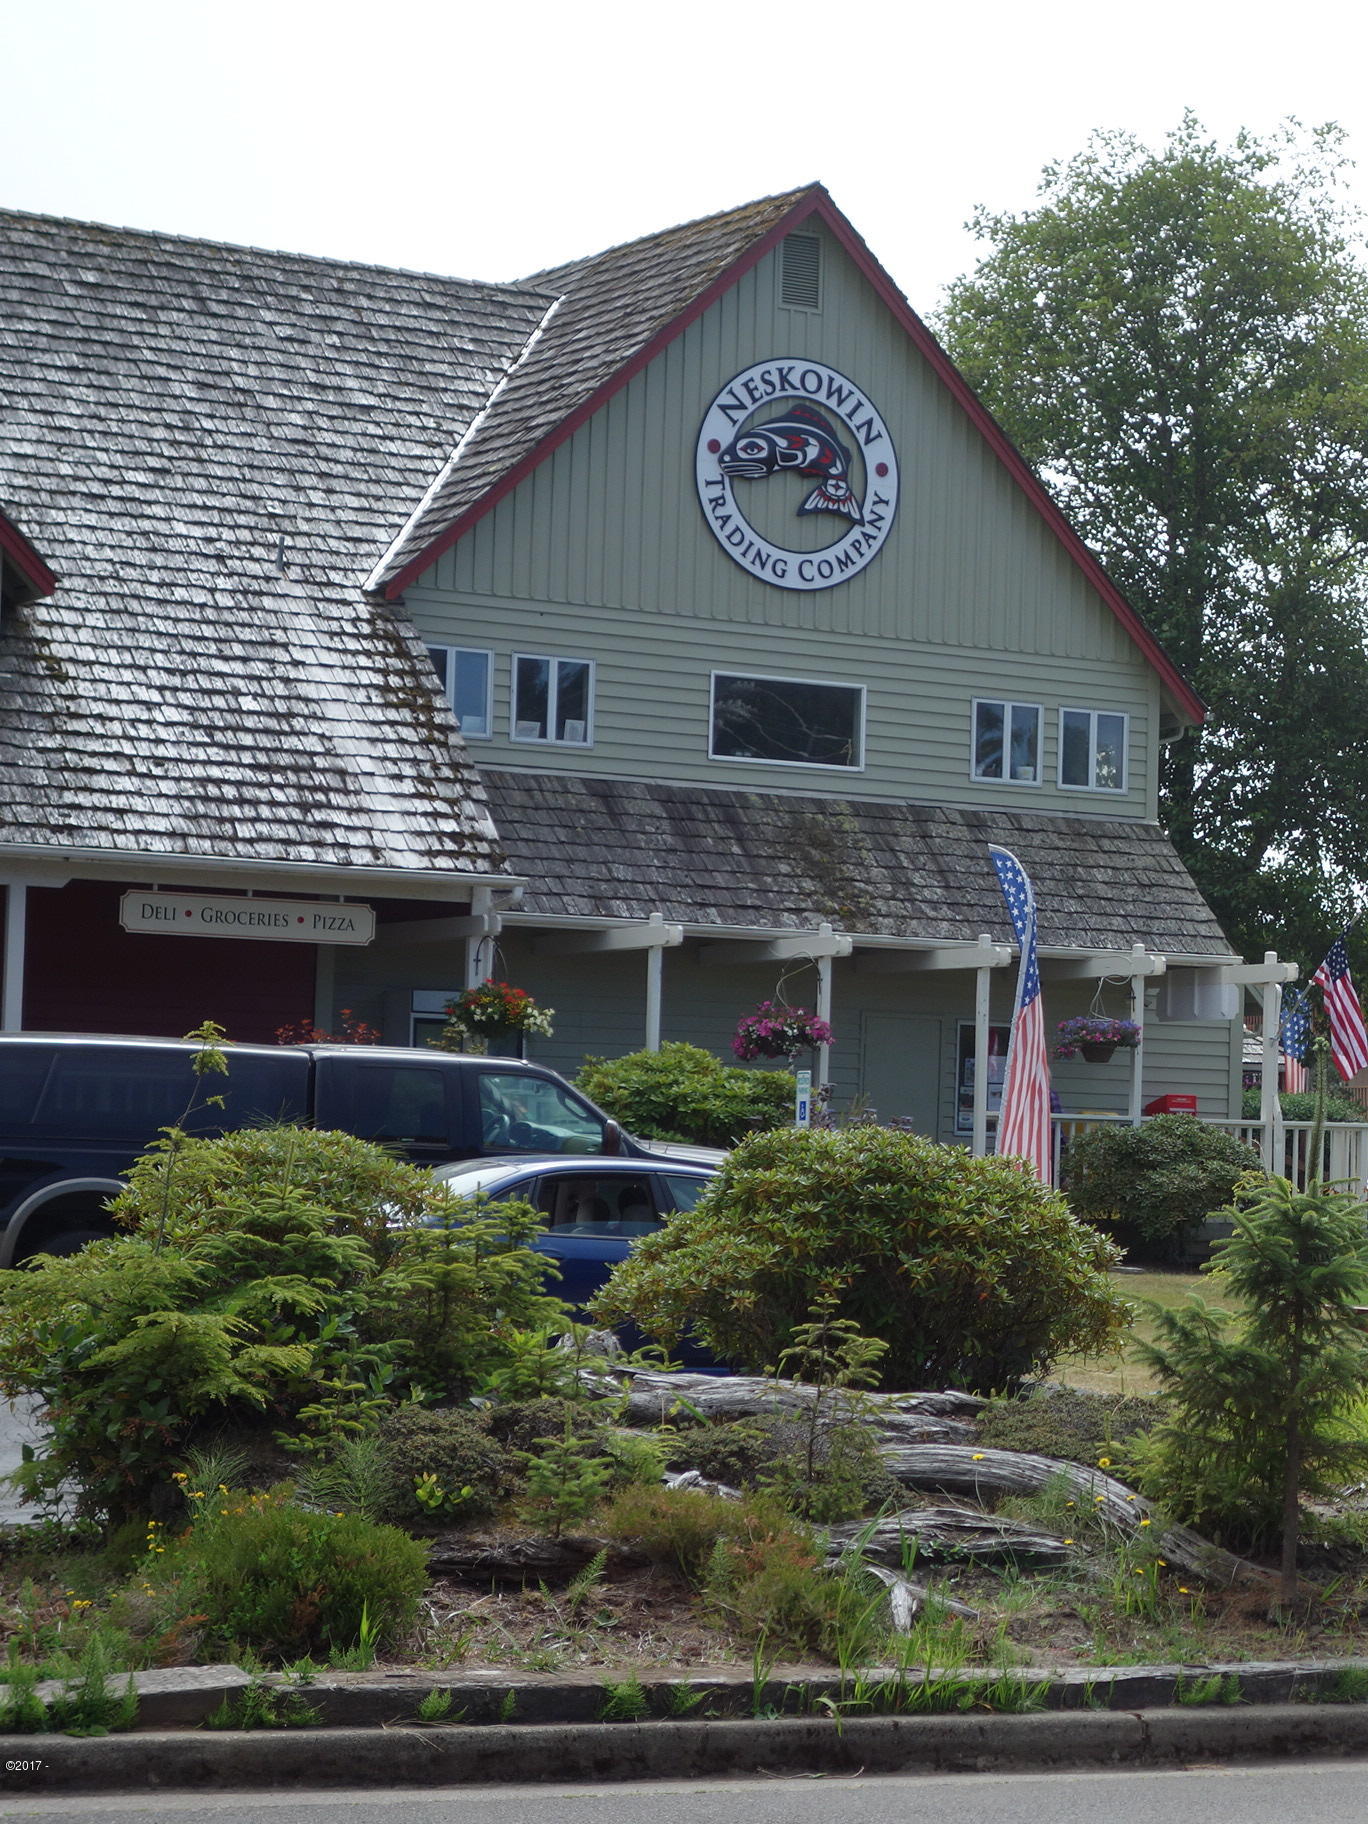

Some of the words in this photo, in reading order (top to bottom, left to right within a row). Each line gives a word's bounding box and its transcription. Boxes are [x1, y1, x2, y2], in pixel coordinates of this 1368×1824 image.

[717, 366, 883, 447] NESKOWIN
[704, 473, 788, 579] TRADING
[797, 490, 890, 582] COMPANY
[141, 903, 177, 921] DELI
[200, 907, 289, 928] GROCERIES
[313, 913, 356, 932] PIZZA
